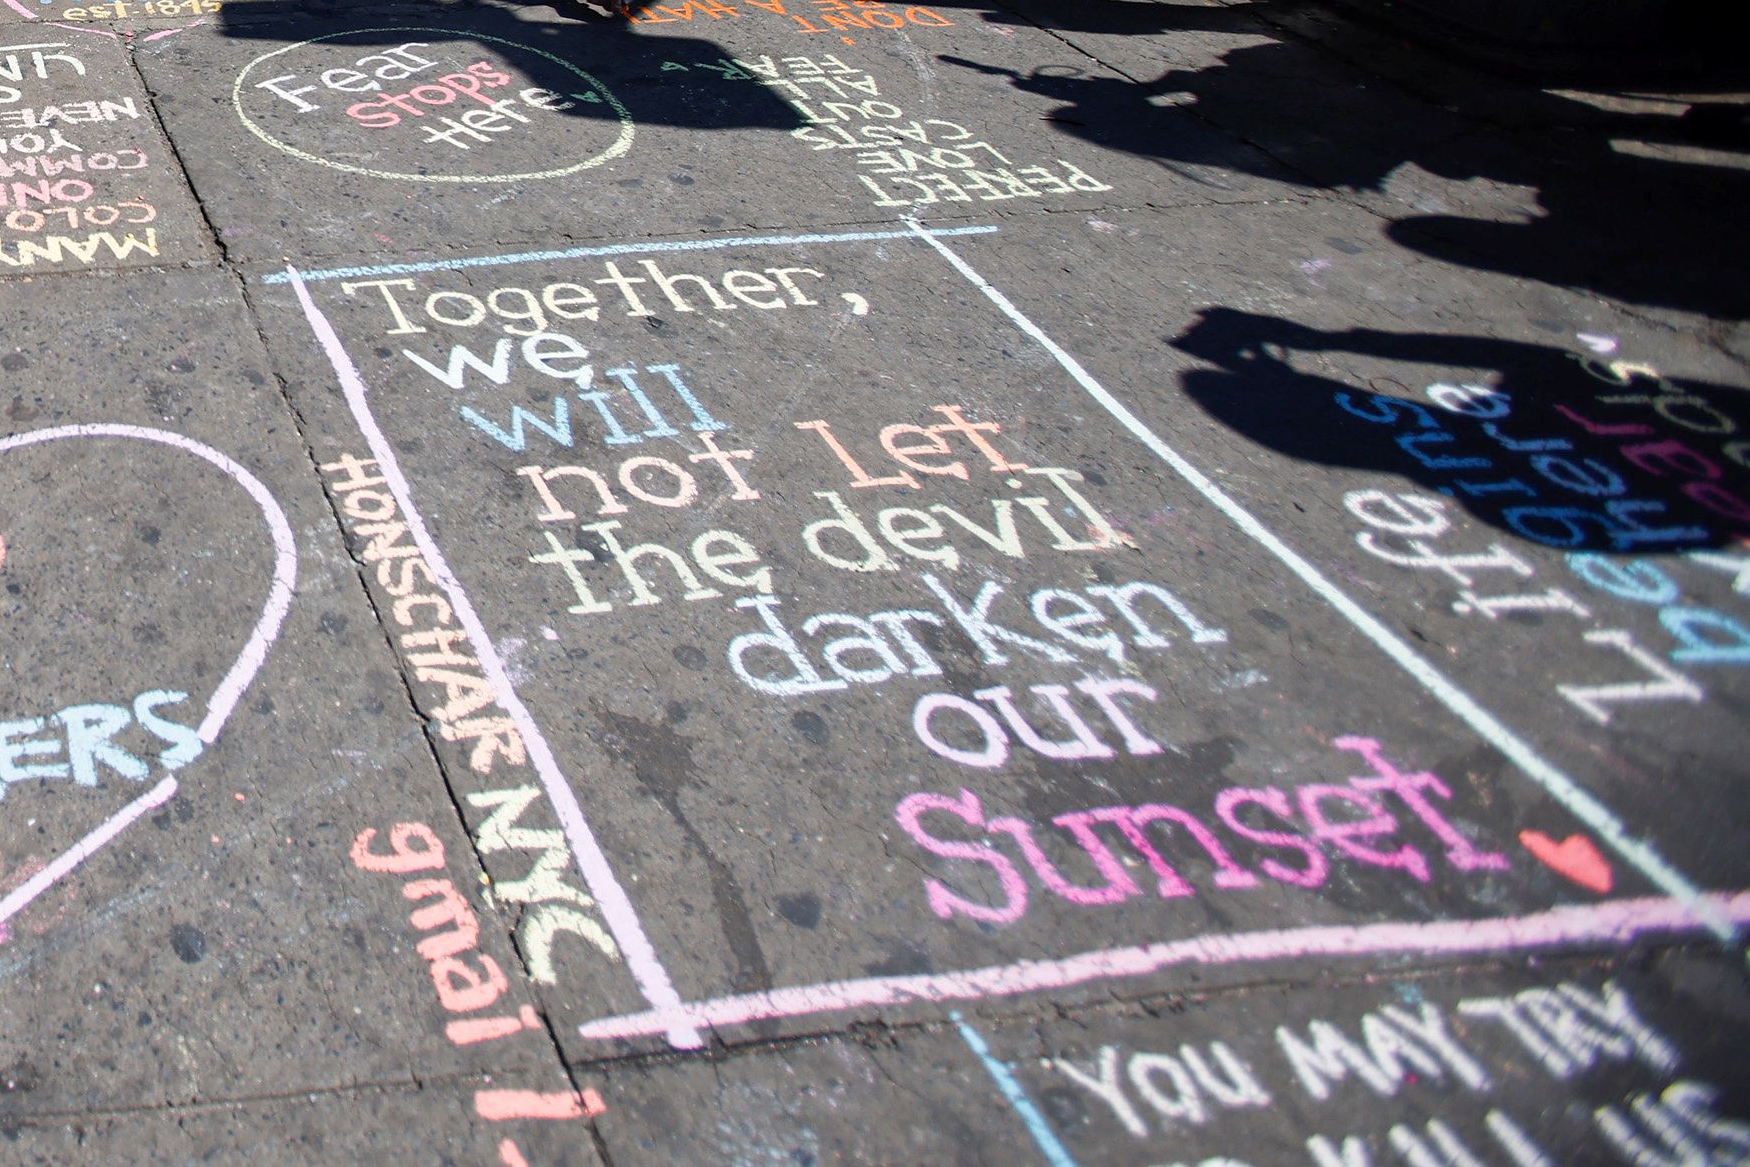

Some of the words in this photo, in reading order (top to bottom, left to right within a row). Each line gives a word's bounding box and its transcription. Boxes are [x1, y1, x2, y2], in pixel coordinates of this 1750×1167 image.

[254, 41, 439, 114] Fear
[419, 86, 577, 150] Here
[788, 99, 903, 127] OUT
[789, 119, 975, 151] CASTS
[858, 140, 1015, 173] LOVE
[857, 159, 1117, 210] PERFECT
[341, 258, 870, 339] Together,
[401, 331, 596, 393] we
[458, 362, 737, 453] will
[514, 430, 763, 524] not
[793, 402, 1033, 493] Let
[528, 519, 776, 618] the
[800, 466, 1143, 575] devil
[726, 573, 1230, 698] darken
[909, 673, 1169, 770] our
[892, 734, 1513, 927] Sunset
[1040, 1039, 1274, 1137] YOU
[1275, 1001, 1493, 1102] MAY
[1456, 978, 1682, 1081] TRY
